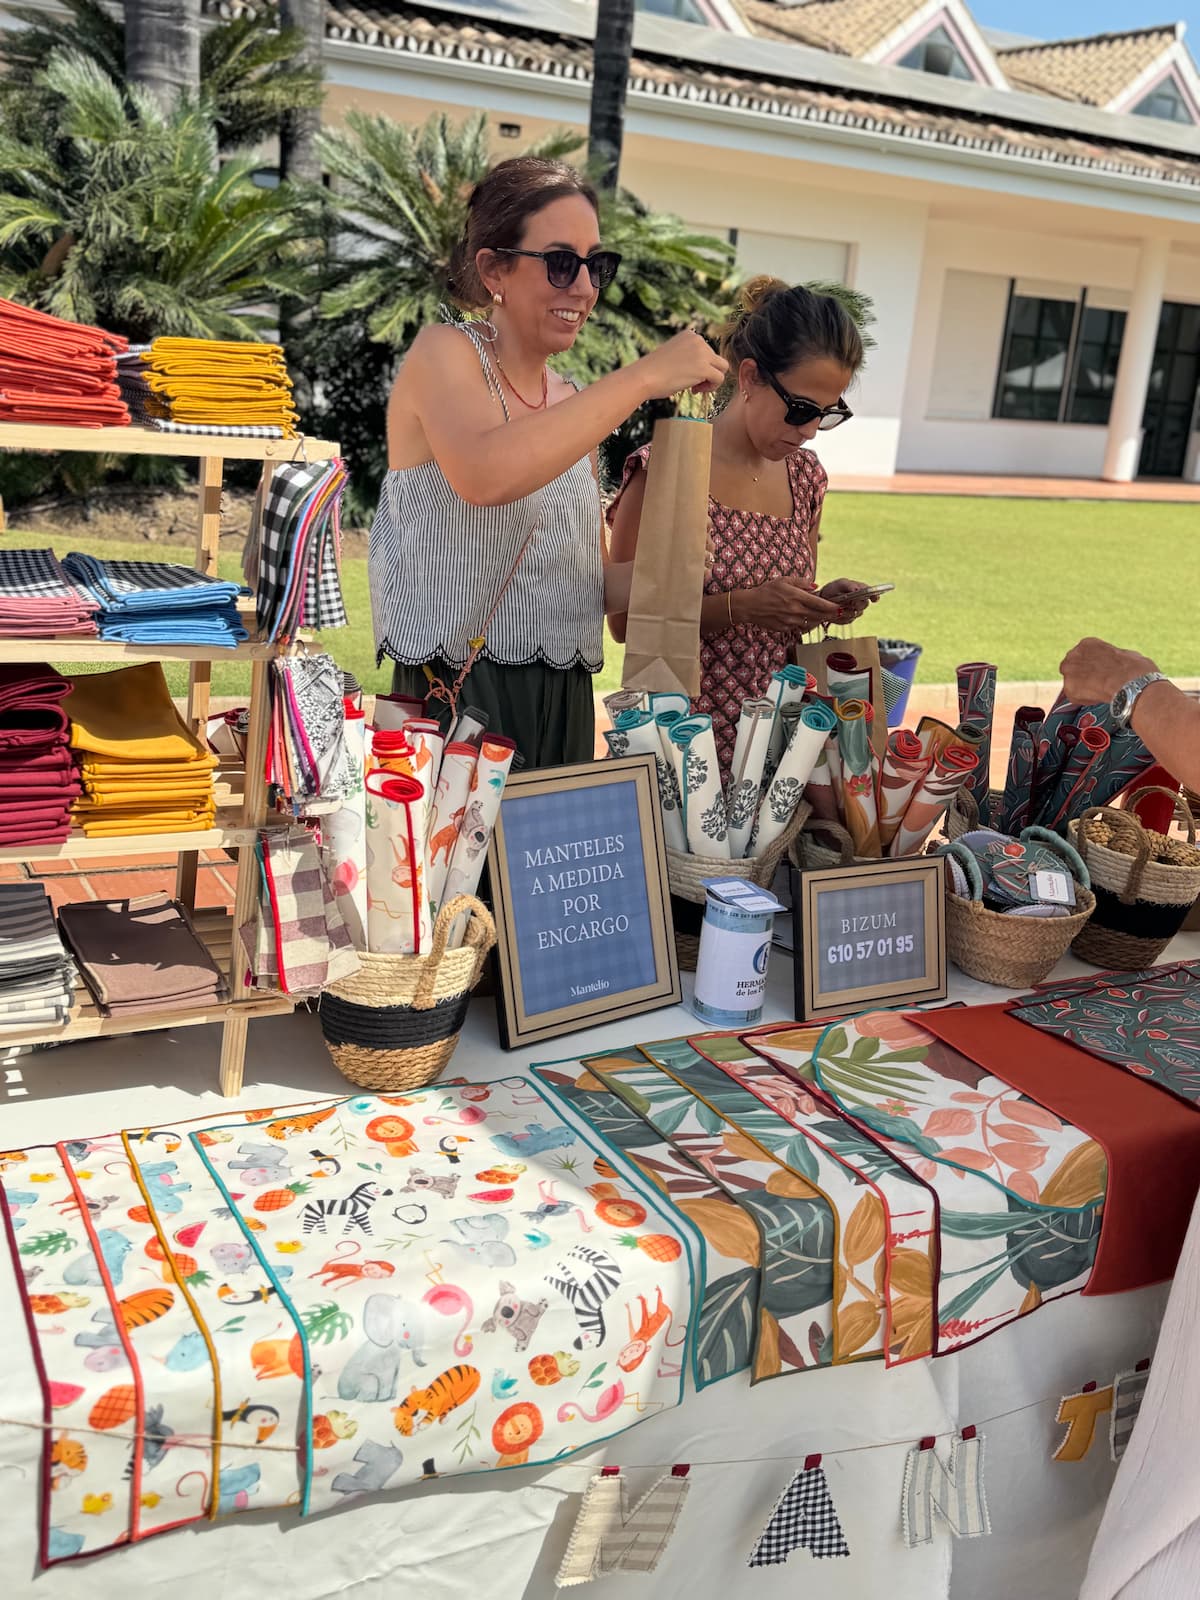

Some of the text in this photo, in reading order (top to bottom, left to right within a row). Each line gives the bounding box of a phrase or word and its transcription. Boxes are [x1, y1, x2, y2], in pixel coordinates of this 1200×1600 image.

[525, 835, 625, 869] MANTELES
[530, 862, 625, 895] A MEDIDA
[562, 893, 602, 917] POR
[537, 914, 629, 950] ENCARGO
[841, 912, 897, 934] BIZUM
[828, 934, 914, 964] 610 57 01 95
[735, 988, 746, 997] de
